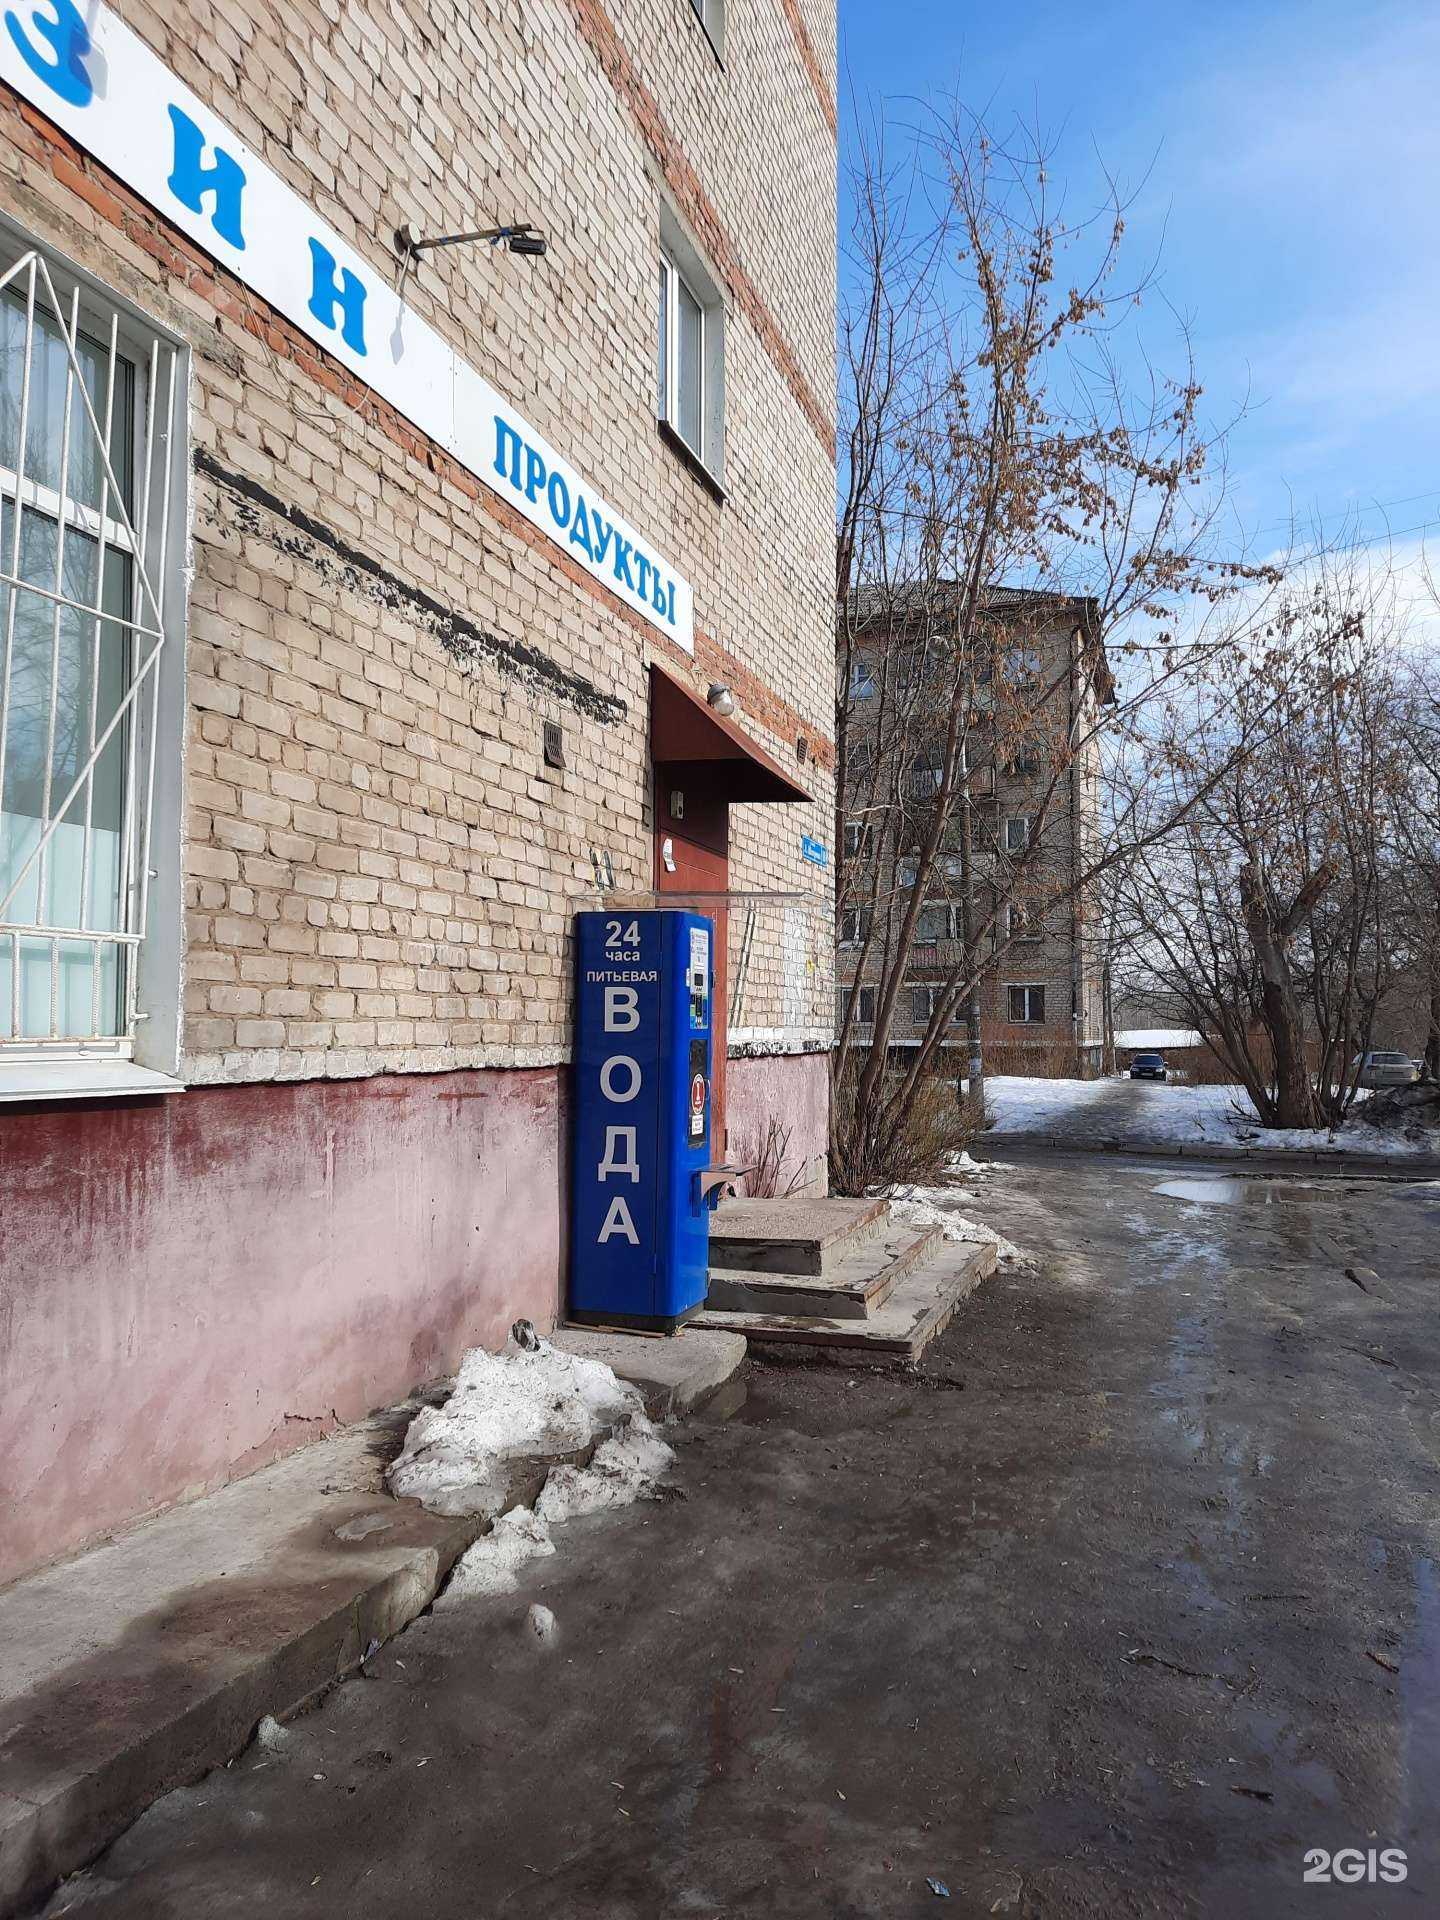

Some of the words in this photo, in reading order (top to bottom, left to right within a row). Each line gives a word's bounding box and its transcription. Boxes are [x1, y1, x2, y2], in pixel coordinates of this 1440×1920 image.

[494, 415, 676, 625] ПРОДУКТЫ
[605, 920, 641, 947] 24
[605, 951, 640, 961] часа
[586, 970, 657, 982] ПИТЬЕВАЯ
[597, 986, 642, 1245] ВОДА
